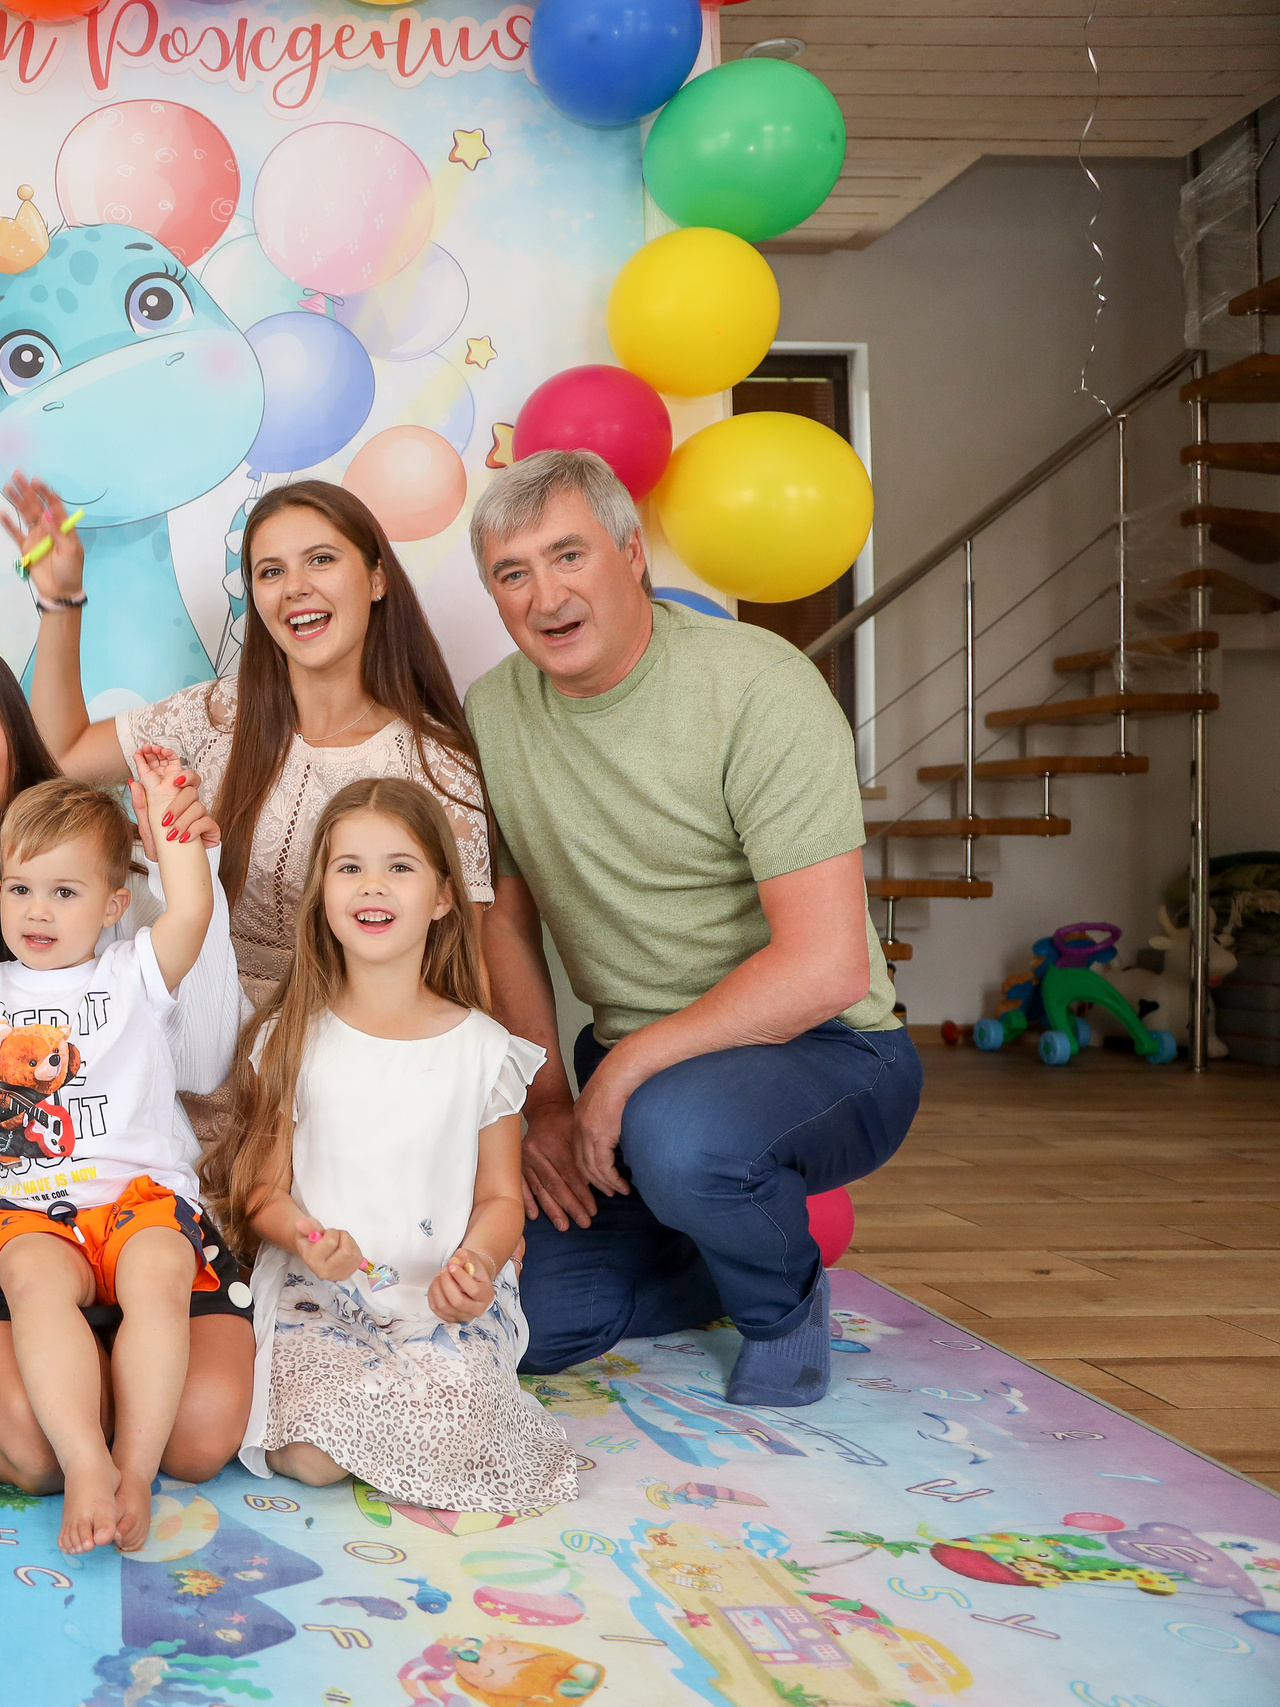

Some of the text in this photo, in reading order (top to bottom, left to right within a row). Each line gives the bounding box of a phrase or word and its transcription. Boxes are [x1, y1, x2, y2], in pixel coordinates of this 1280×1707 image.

[78, 991, 111, 1036] IT
[23, 1176, 52, 1195] HAVE
[55, 1172, 68, 1188] IS
[70, 1165, 98, 1184] NOW
[41, 1193, 51, 1201] BE
[52, 1189, 70, 1200] COOL
